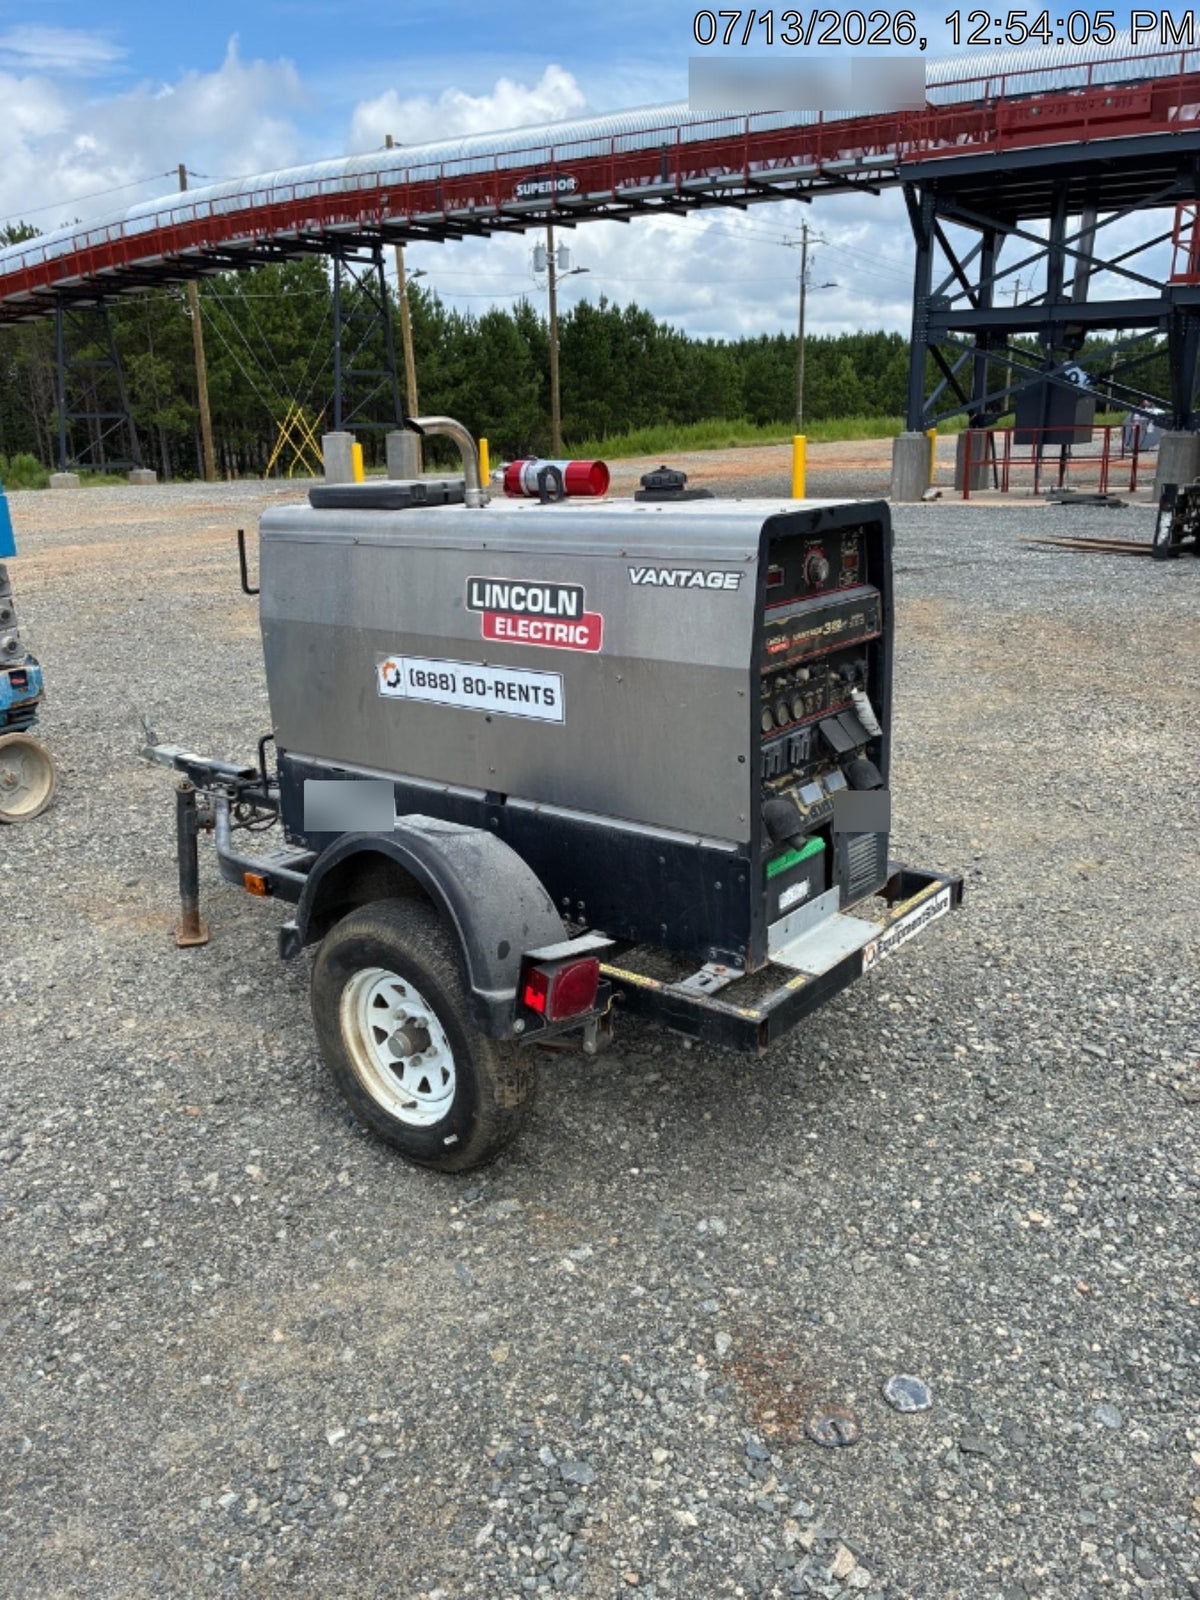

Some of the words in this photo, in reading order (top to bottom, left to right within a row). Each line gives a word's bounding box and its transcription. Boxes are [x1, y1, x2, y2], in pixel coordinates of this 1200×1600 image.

[516, 178, 575, 197] SUPERIOR
[628, 567, 741, 591] VANTAGE
[472, 583, 578, 616] LINCOLN
[495, 616, 589, 645] ELECTRIC
[409, 668, 456, 694] (888)
[463, 677, 556, 706] 80-RENTS
